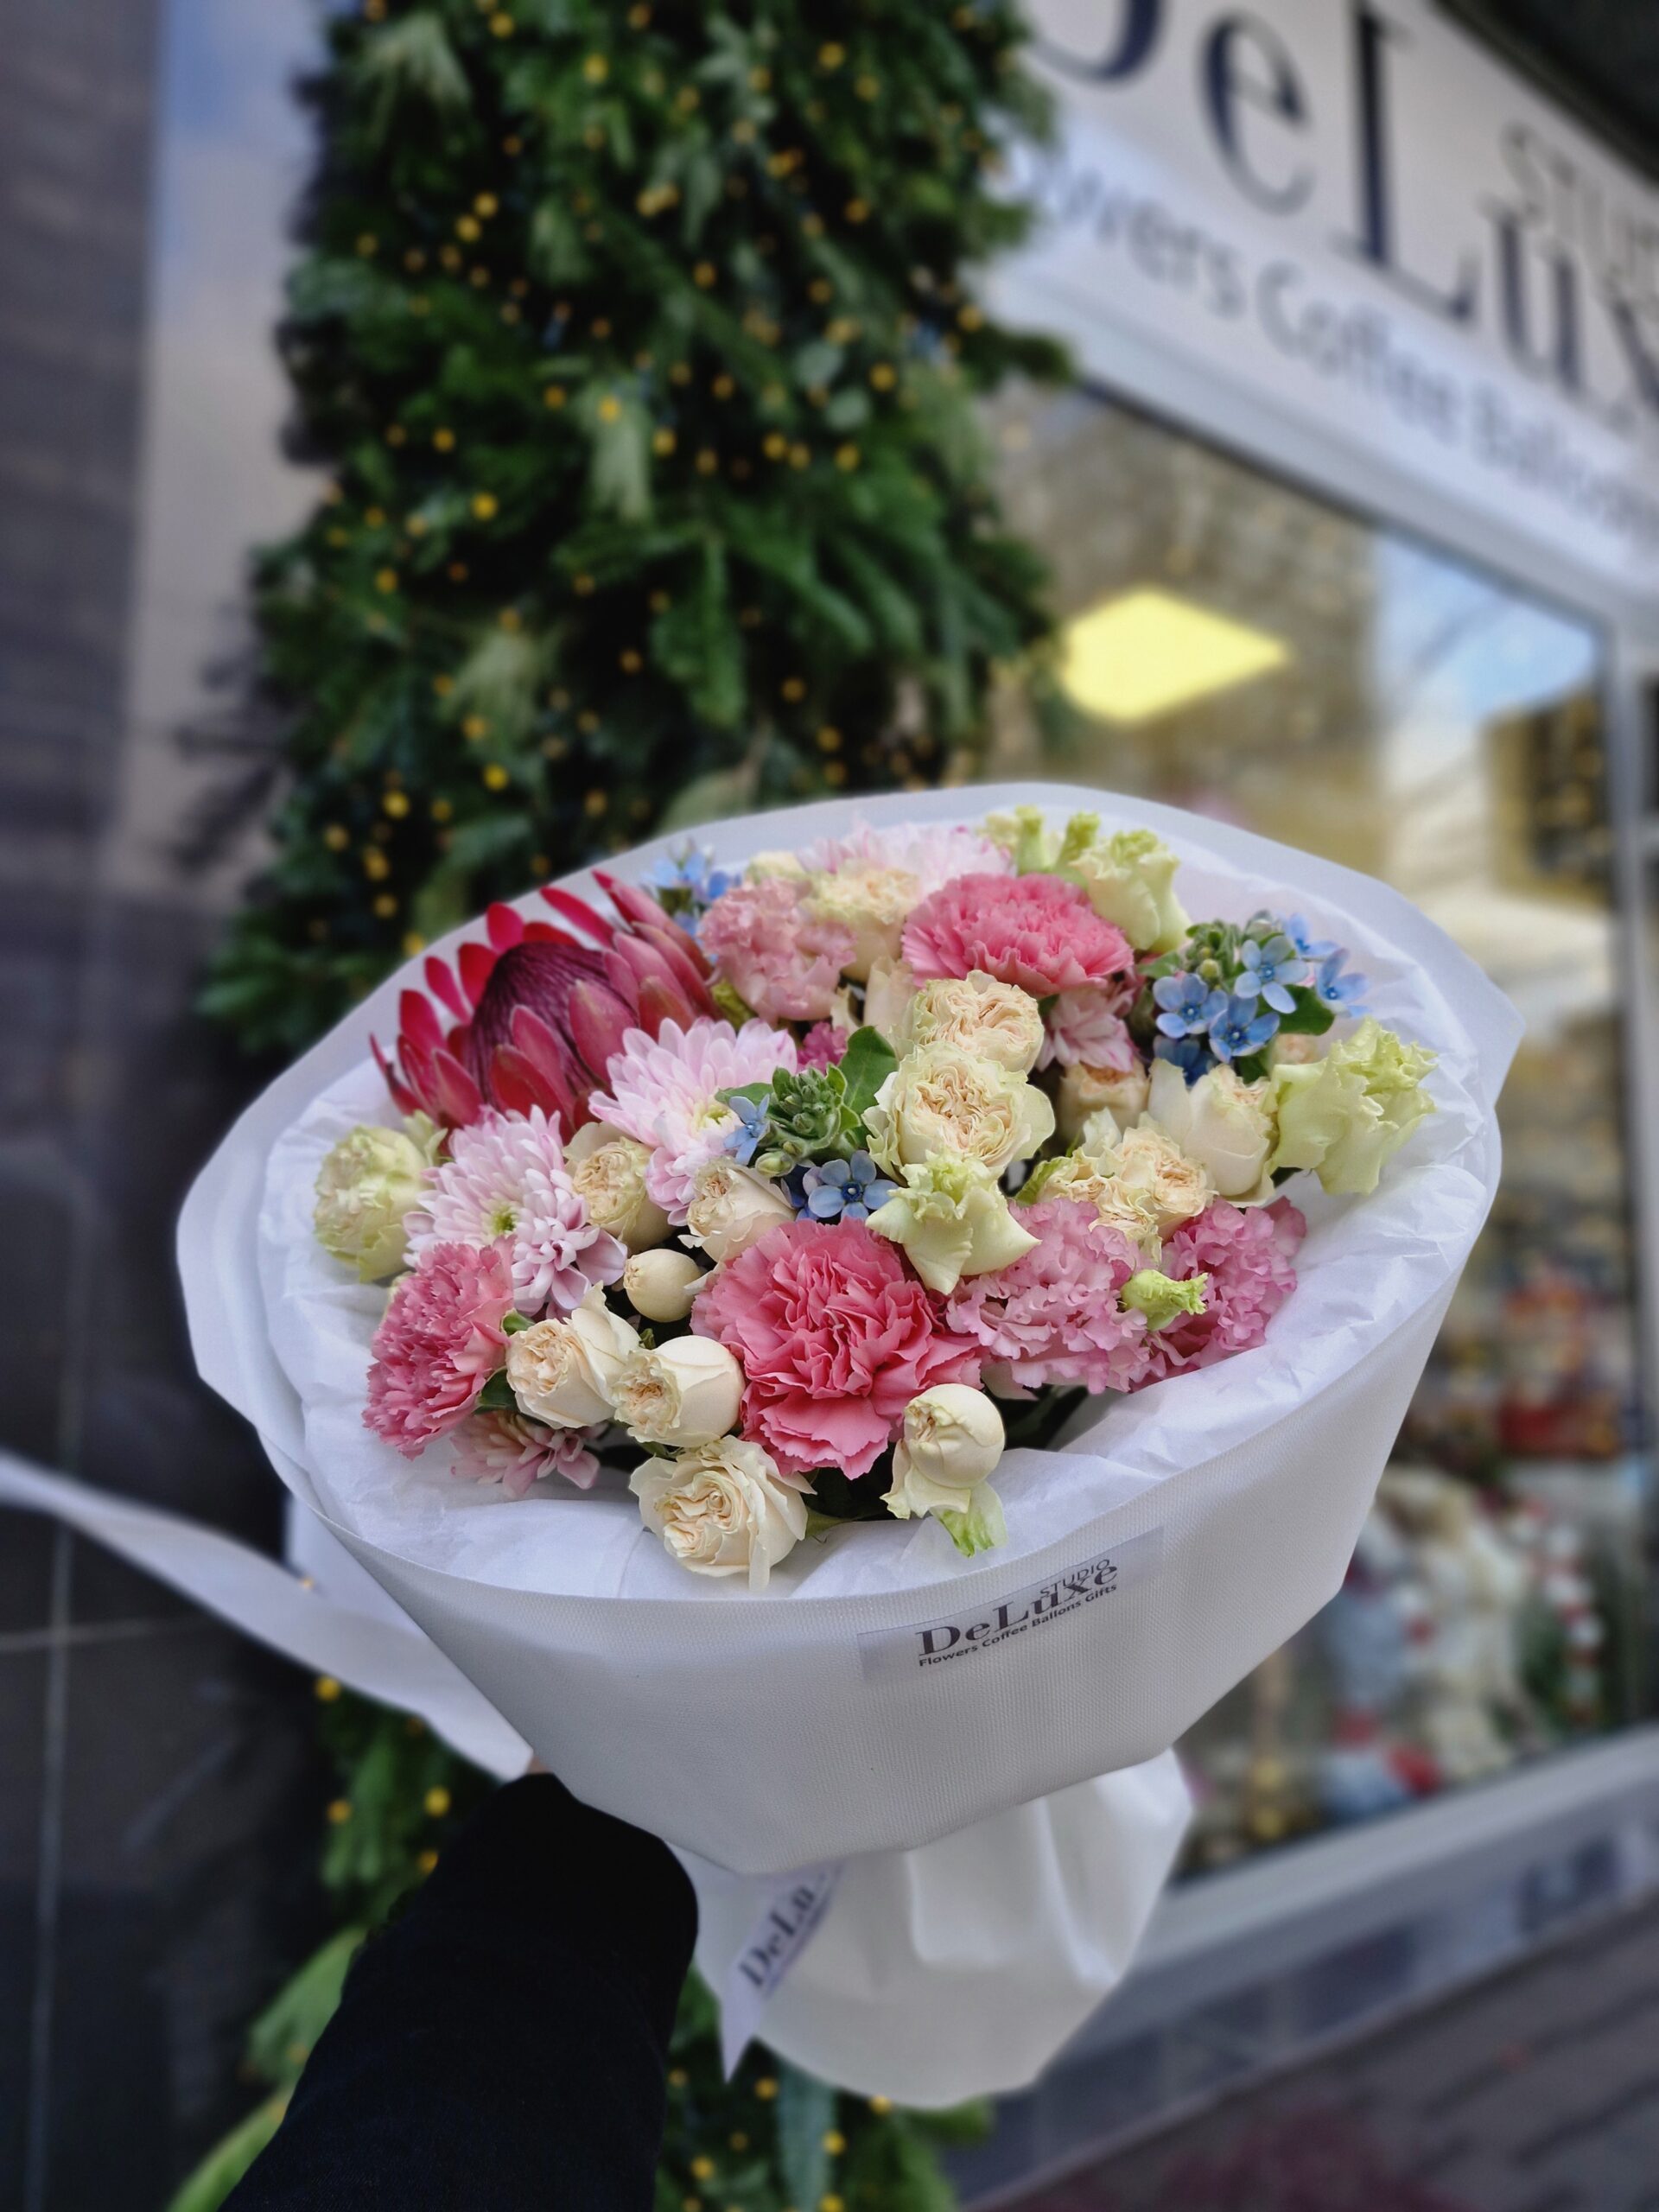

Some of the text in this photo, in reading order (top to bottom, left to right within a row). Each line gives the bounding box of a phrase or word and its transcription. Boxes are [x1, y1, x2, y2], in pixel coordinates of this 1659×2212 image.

[915, 1566, 1117, 1656] DeLuxe
[1039, 1559, 1110, 1598] STUDIO
[918, 1584, 1117, 1667] Flowers Coffee Ballons Gifts
